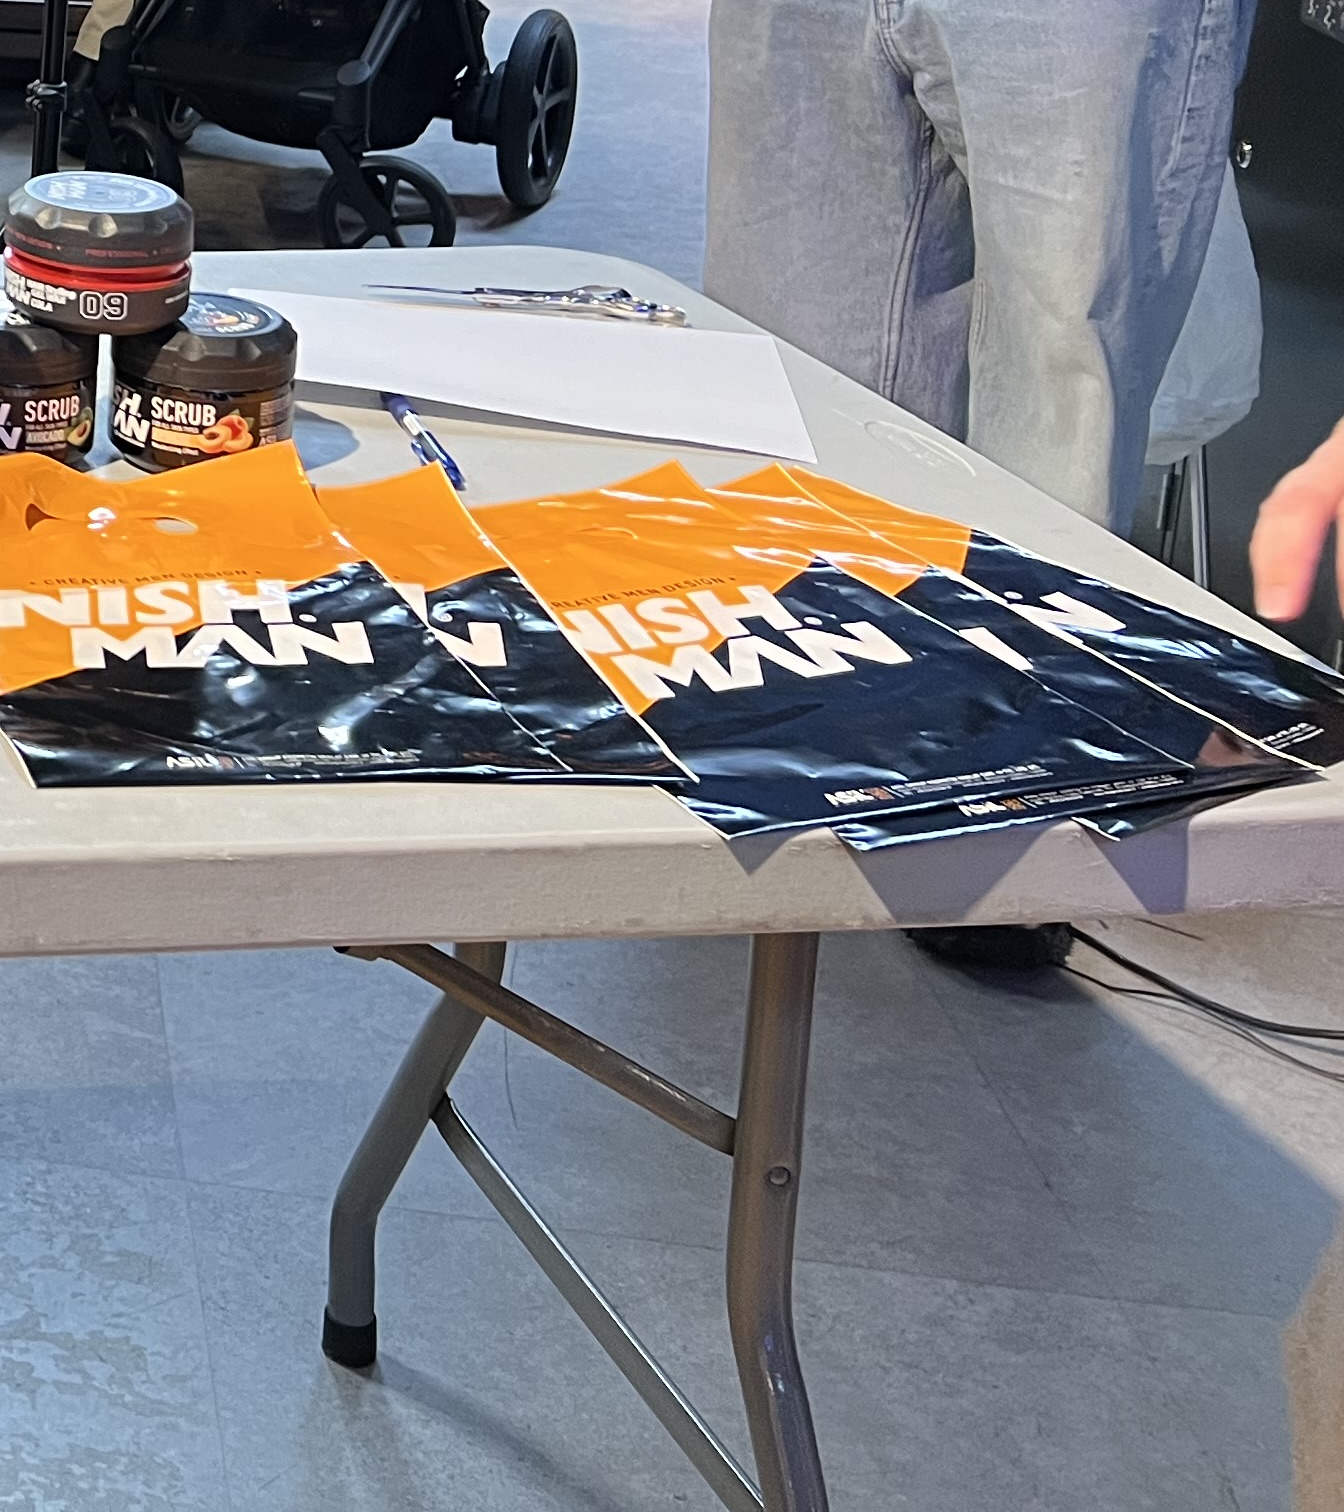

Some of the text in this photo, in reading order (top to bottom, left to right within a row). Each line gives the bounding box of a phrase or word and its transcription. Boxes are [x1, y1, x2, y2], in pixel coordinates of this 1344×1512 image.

[79, 290, 129, 321] 09
[23, 394, 81, 423] SCRUB
[150, 396, 218, 428] SCRUB
[44, 569, 249, 587] CREATIVE MEN DESIGN
[622, 577, 724, 601] MEN DESIGN
[70, 621, 375, 669] MAN
[610, 619, 913, 700] MAN
